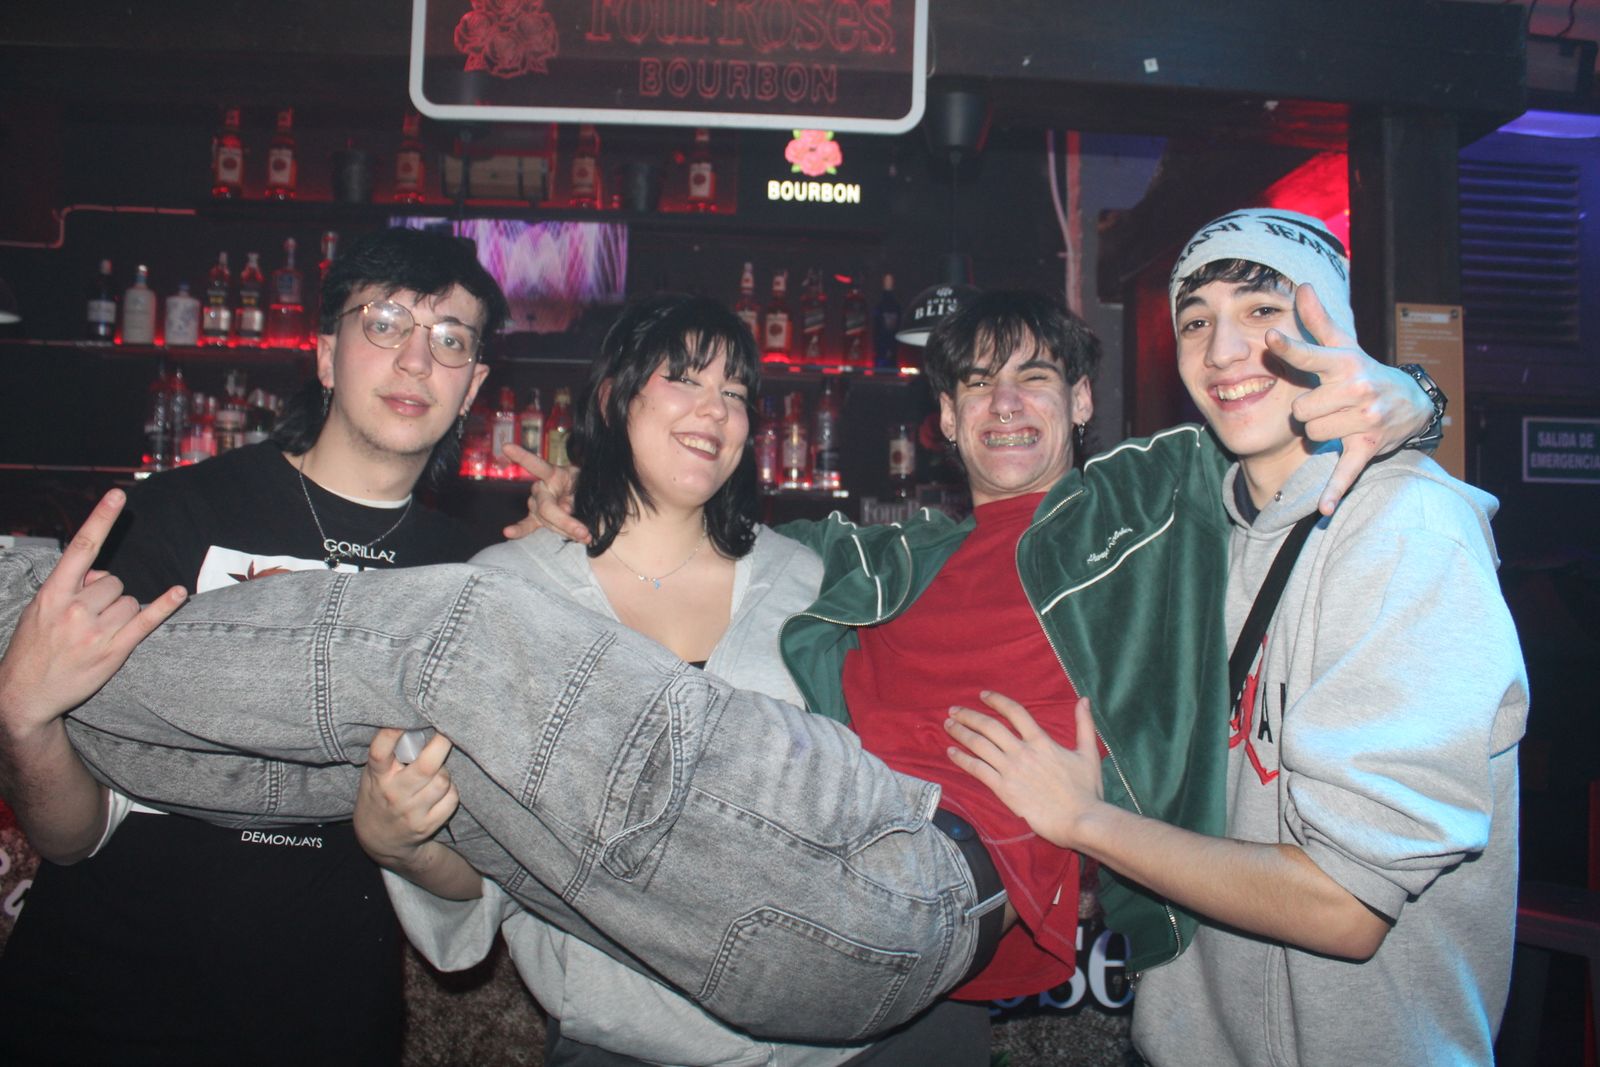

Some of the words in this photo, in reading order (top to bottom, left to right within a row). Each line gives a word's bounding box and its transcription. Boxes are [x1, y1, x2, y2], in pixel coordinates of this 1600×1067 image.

[640, 58, 838, 103] BOURBON
[767, 180, 861, 204] BOURBON
[1537, 431, 1577, 448] SALIDA
[1579, 432, 1596, 448] DE
